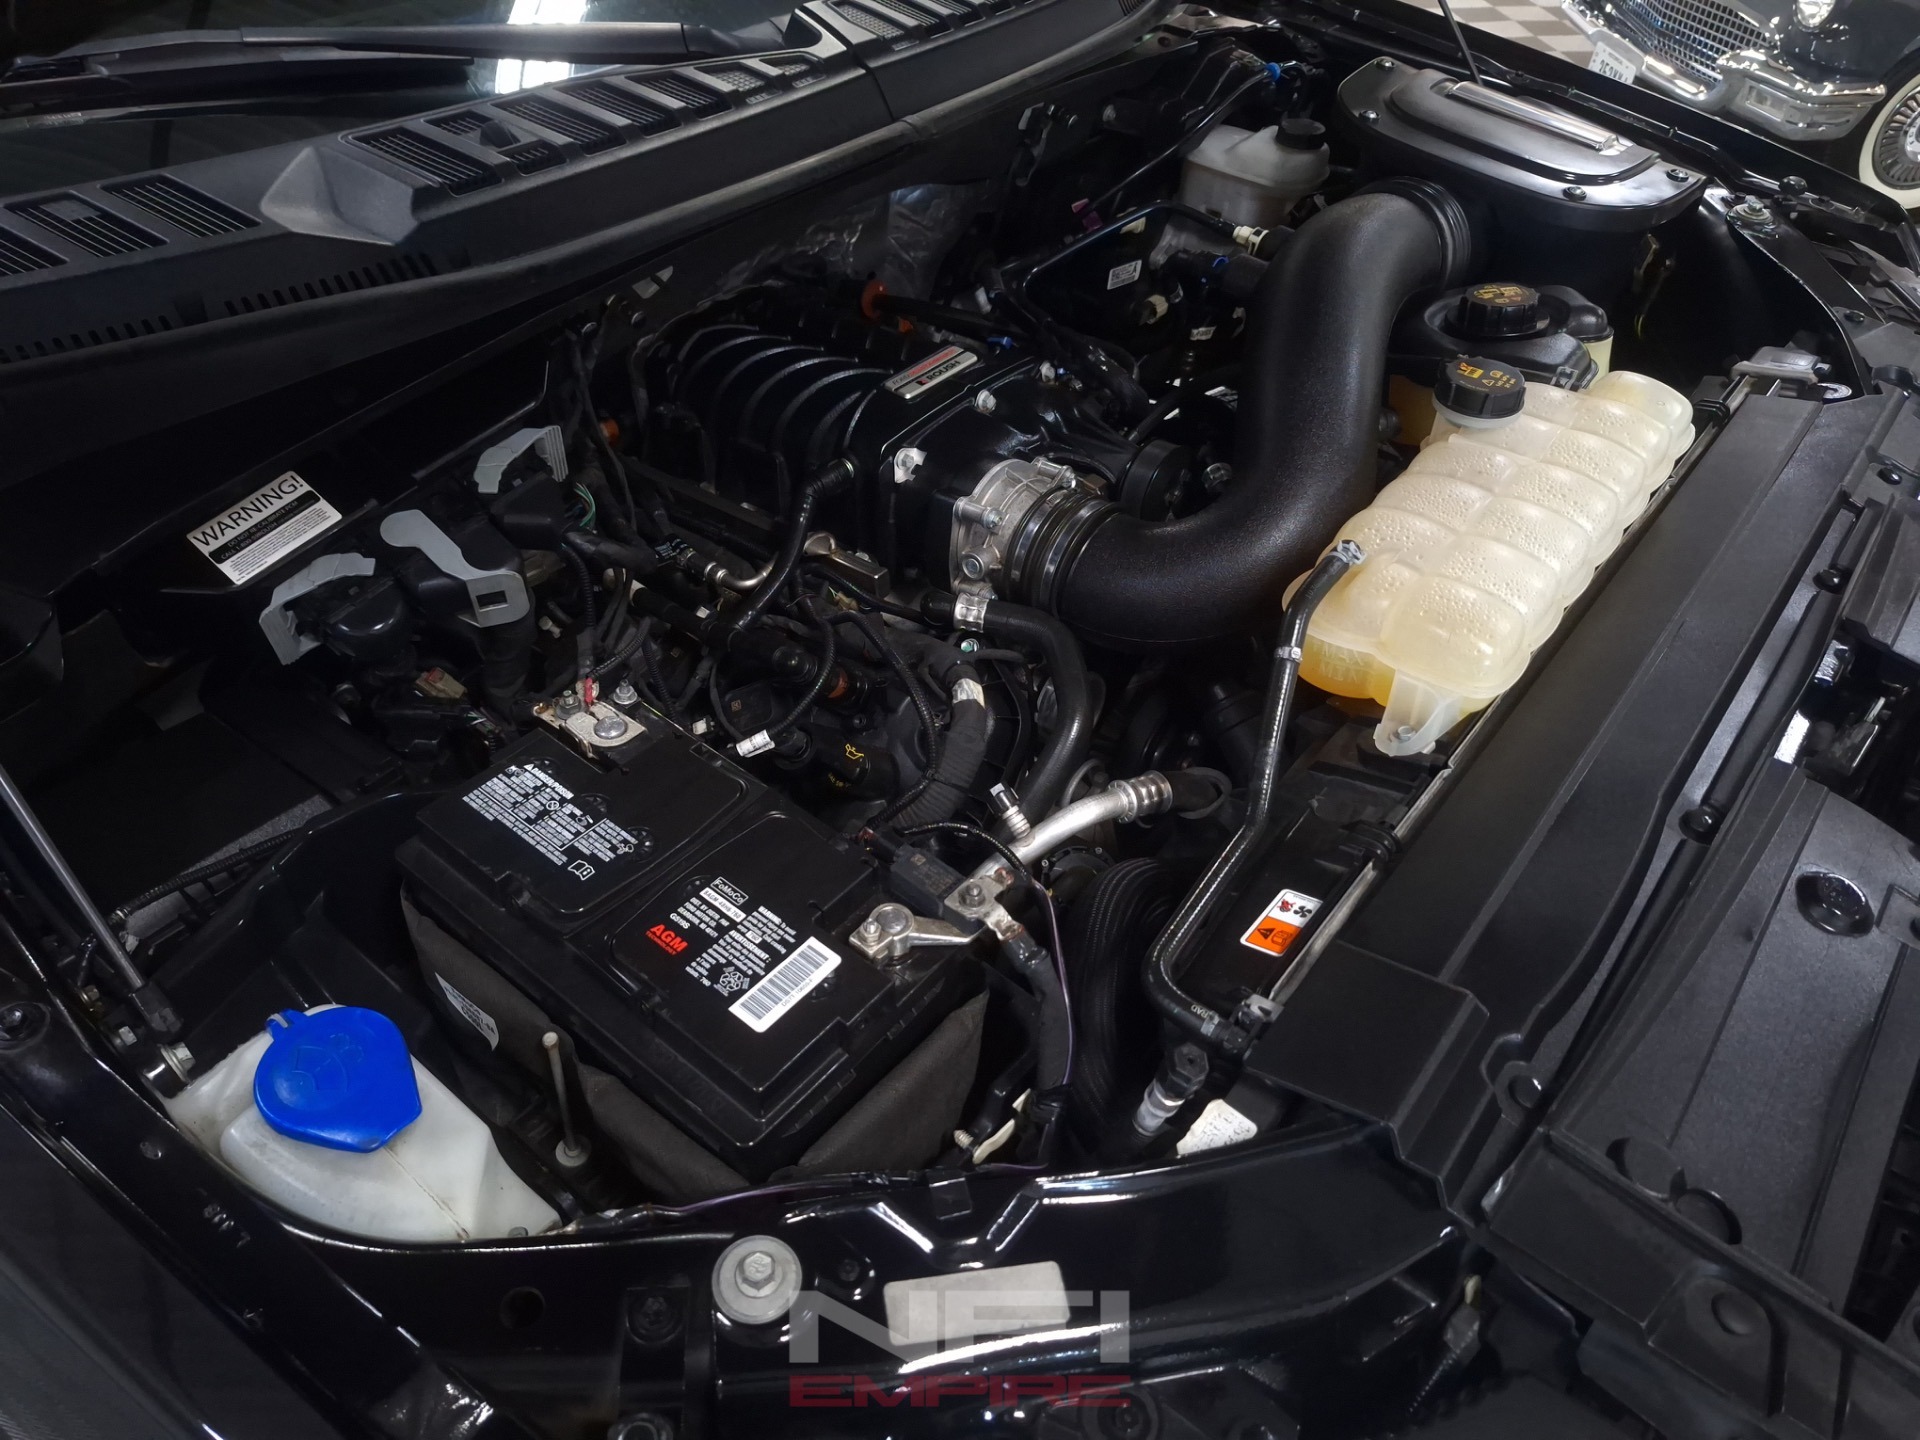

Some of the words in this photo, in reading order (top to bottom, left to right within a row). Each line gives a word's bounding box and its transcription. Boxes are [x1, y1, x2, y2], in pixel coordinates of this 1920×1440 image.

[193, 475, 304, 546] WARNING!
[713, 880, 745, 902] FoMoCo
[650, 924, 688, 954] AGM
